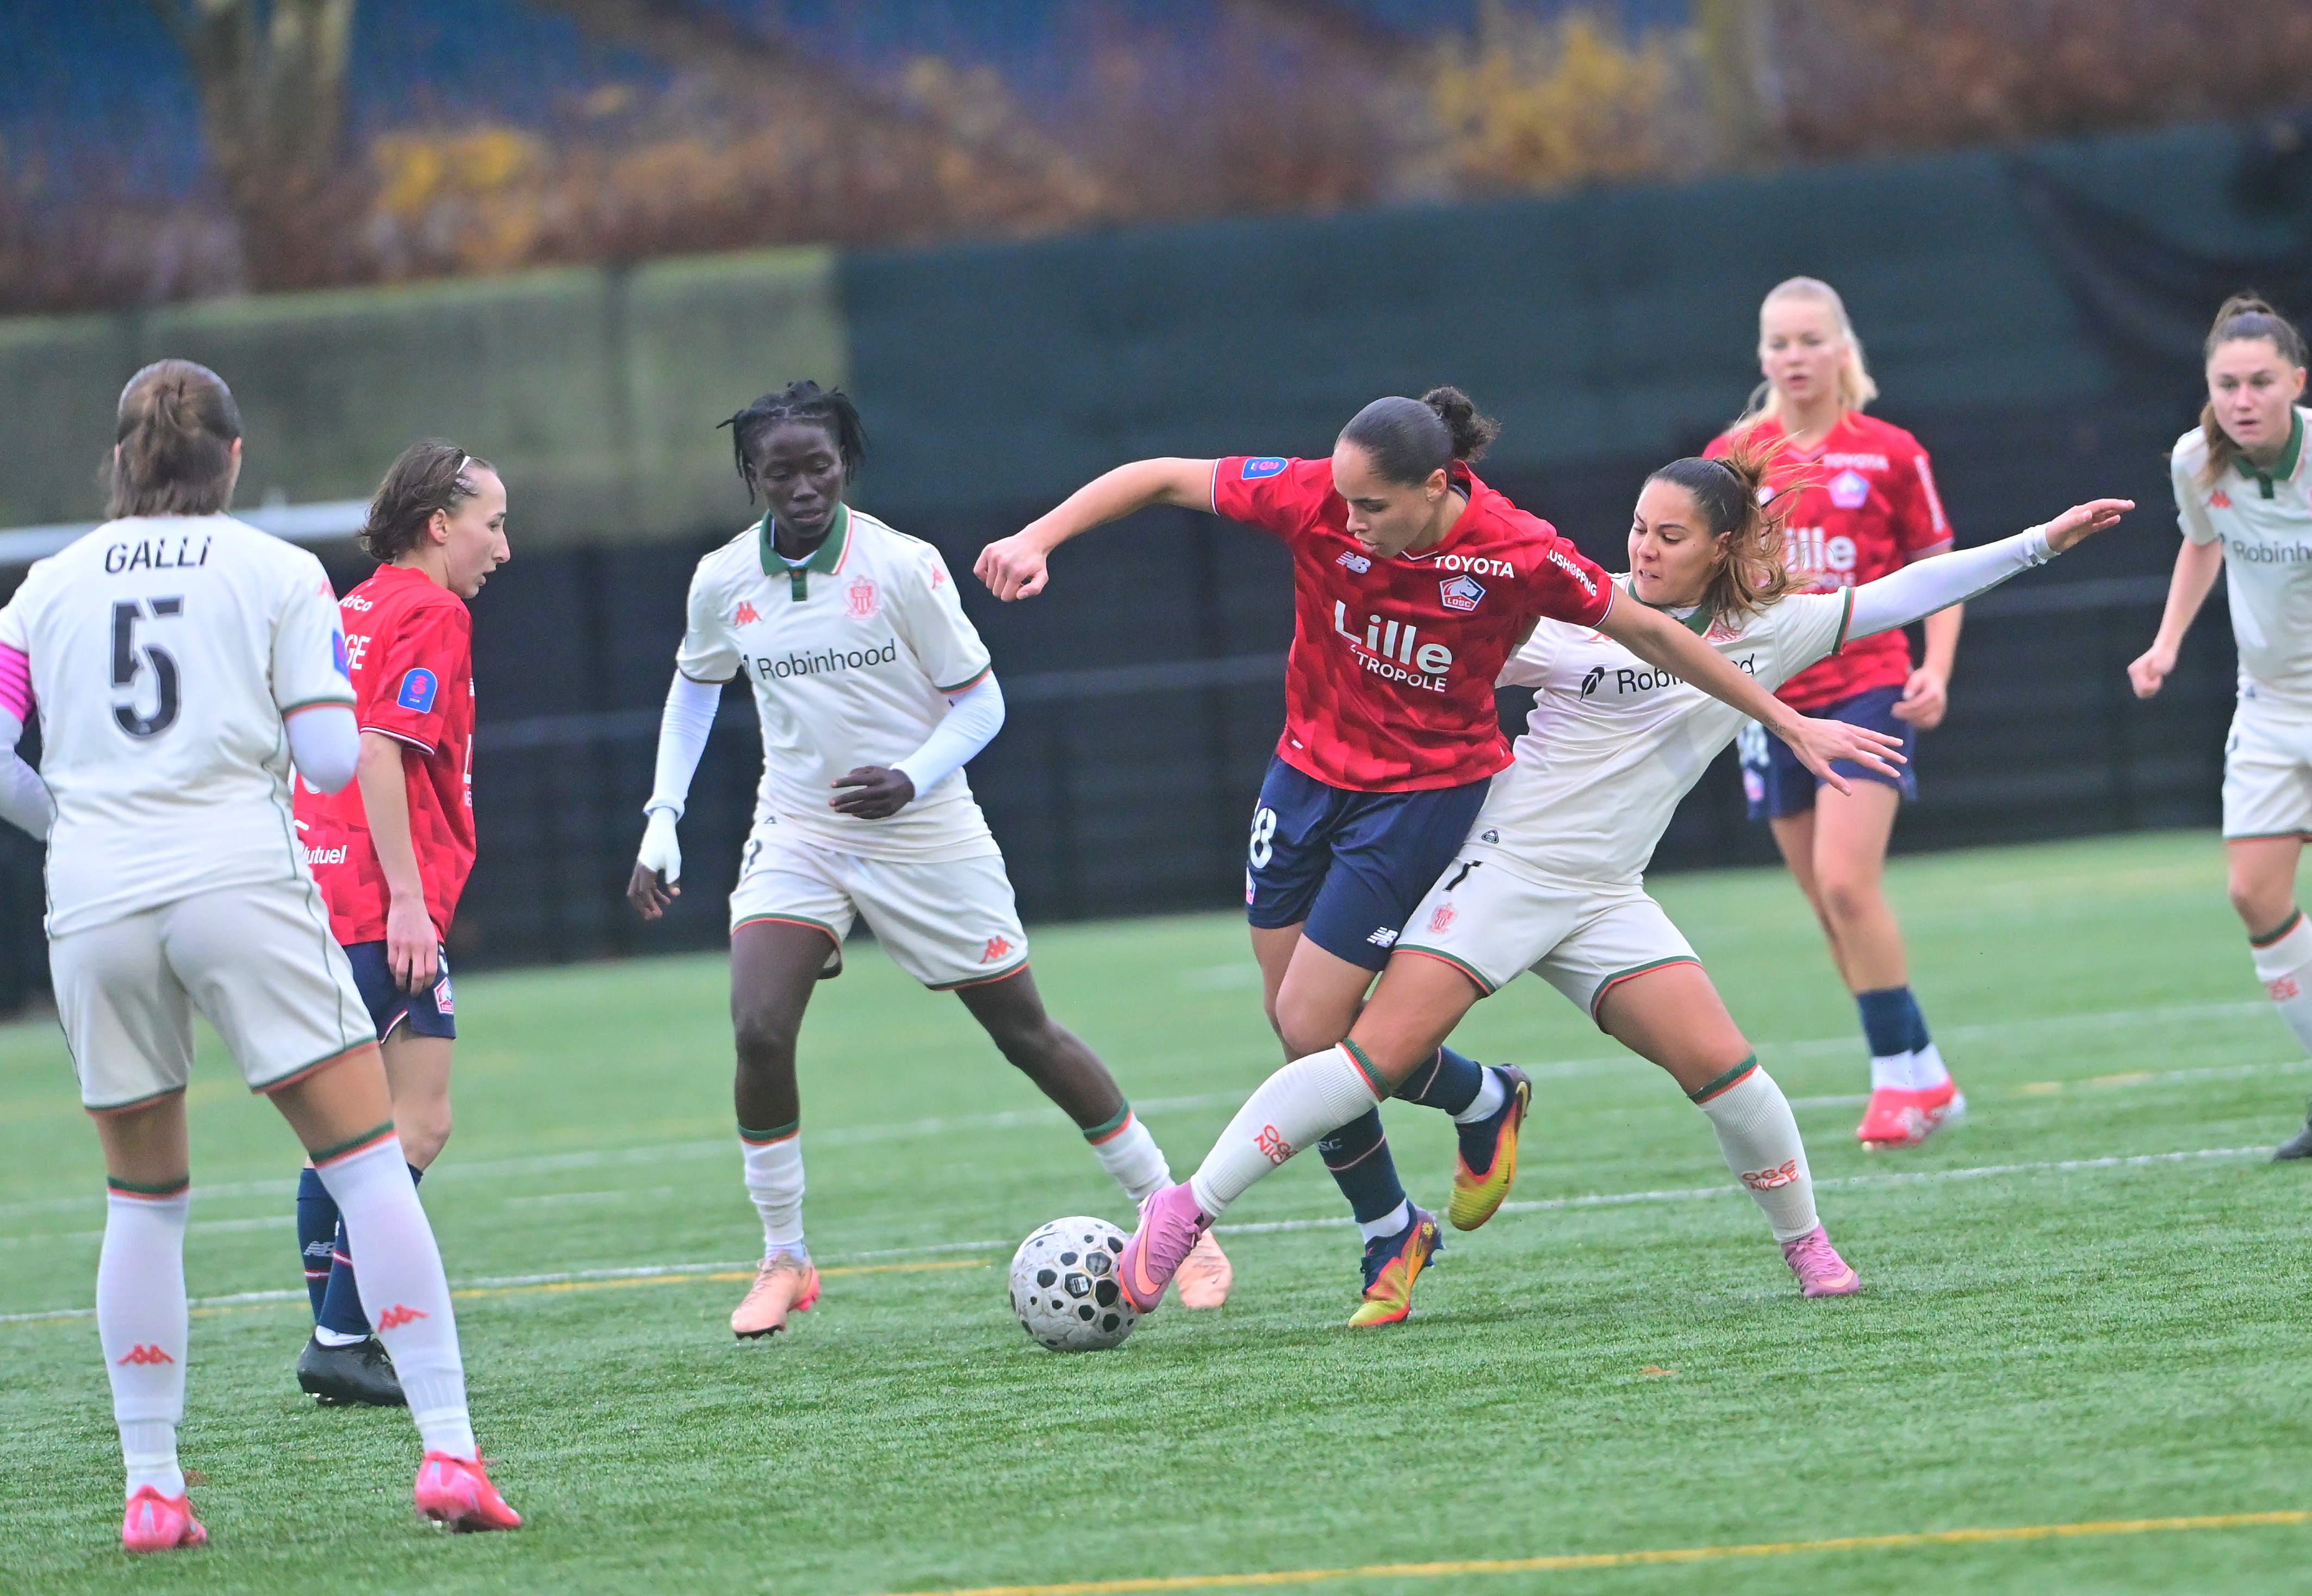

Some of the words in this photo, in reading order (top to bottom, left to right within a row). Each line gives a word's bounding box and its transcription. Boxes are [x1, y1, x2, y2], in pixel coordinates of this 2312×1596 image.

[105, 536, 211, 573] GALLI
[1434, 554, 1515, 578] TOYOTA
[1546, 549, 1597, 596] USHOPPING
[339, 595, 373, 612] tico
[1447, 597, 1471, 608] LOSC
[344, 634, 371, 670] GE
[1334, 599, 1452, 674] Lille
[110, 595, 184, 740] 5
[757, 638, 896, 679] Robinhood
[1250, 797, 1277, 869] 8
[303, 845, 347, 864] utuel
